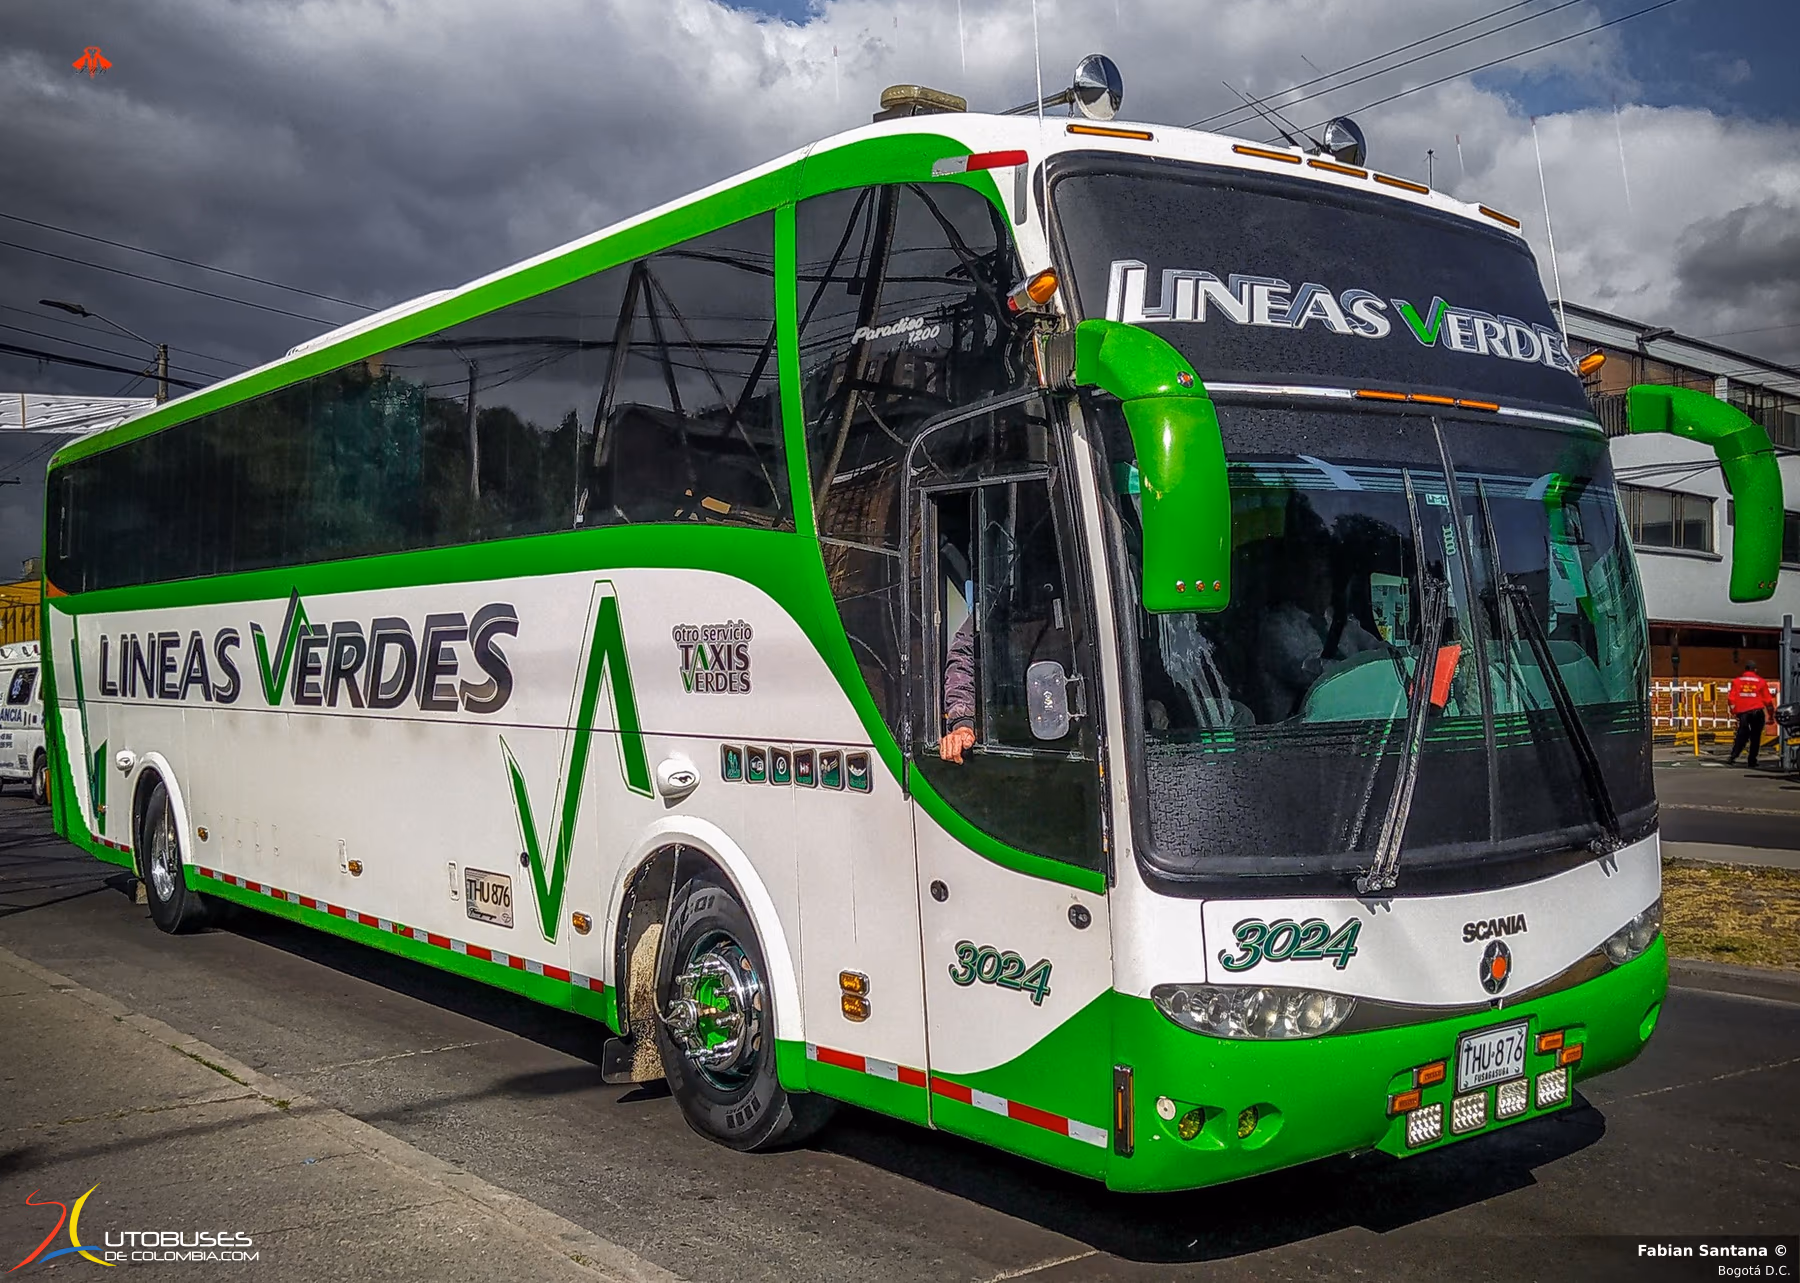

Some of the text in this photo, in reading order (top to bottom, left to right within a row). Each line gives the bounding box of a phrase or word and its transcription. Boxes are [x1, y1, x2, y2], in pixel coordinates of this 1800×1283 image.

[1105, 259, 1390, 339] LINEAS
[851, 316, 924, 345] Paradiso
[908, 325, 940, 344] 1200
[673, 621, 752, 642] otro servicio
[98, 585, 520, 714] LINEAS VERDES
[679, 643, 750, 671] TAXIS
[681, 670, 751, 693] VERDES
[1462, 913, 1528, 943] SCANIA
[1218, 917, 1362, 972] 3024
[948, 940, 1053, 1007] 3024
